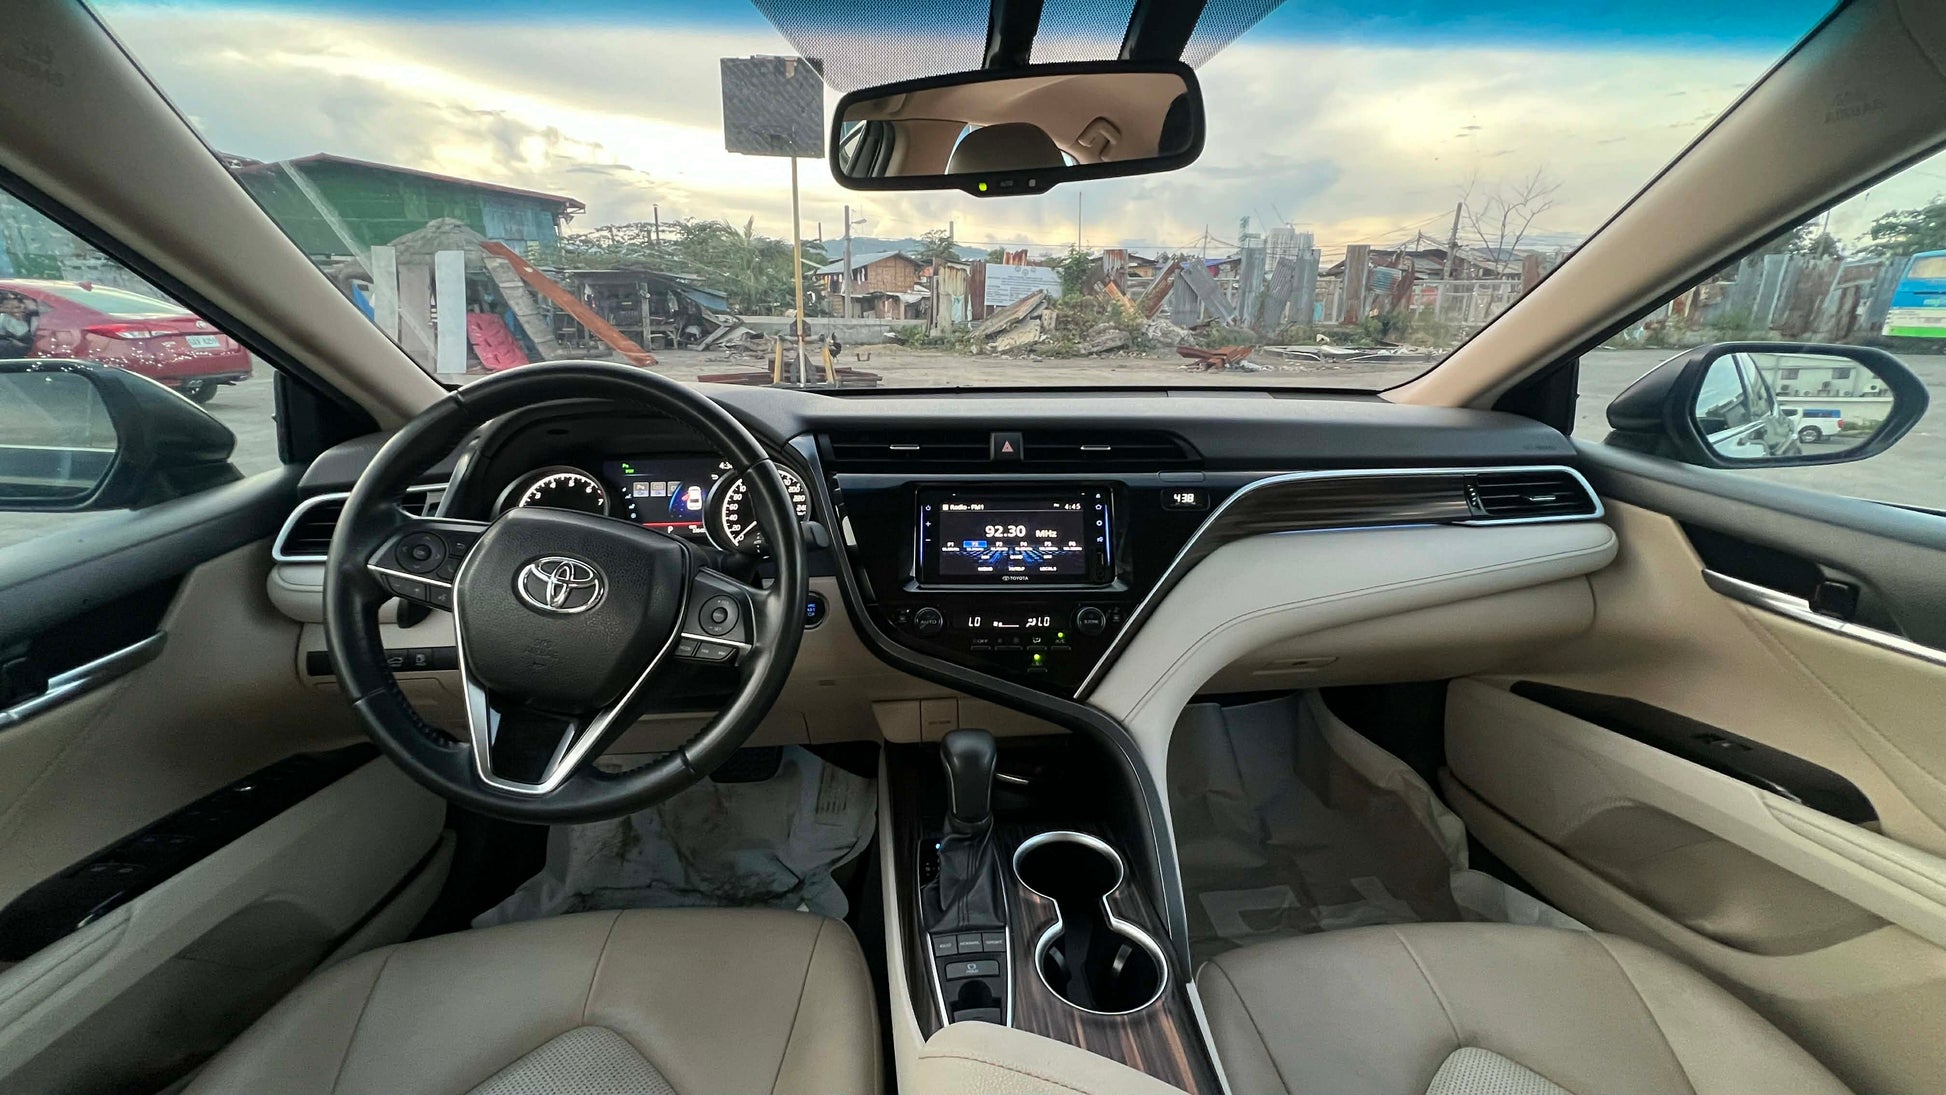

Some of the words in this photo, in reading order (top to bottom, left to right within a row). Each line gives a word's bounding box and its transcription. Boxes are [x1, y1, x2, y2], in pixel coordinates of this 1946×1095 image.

[549, 481, 556, 489] 4
[585, 486, 593, 494] 6
[733, 493, 742, 501] 80
[598, 498, 604, 506] 7
[728, 503, 738, 511] 60
[1064, 503, 1081, 511] 4:45
[668, 525, 674, 534] P
[985, 525, 1026, 538] 92.30
[1035, 529, 1057, 538] MHz
[968, 616, 981, 627] LO
[1037, 616, 1050, 627] LO
